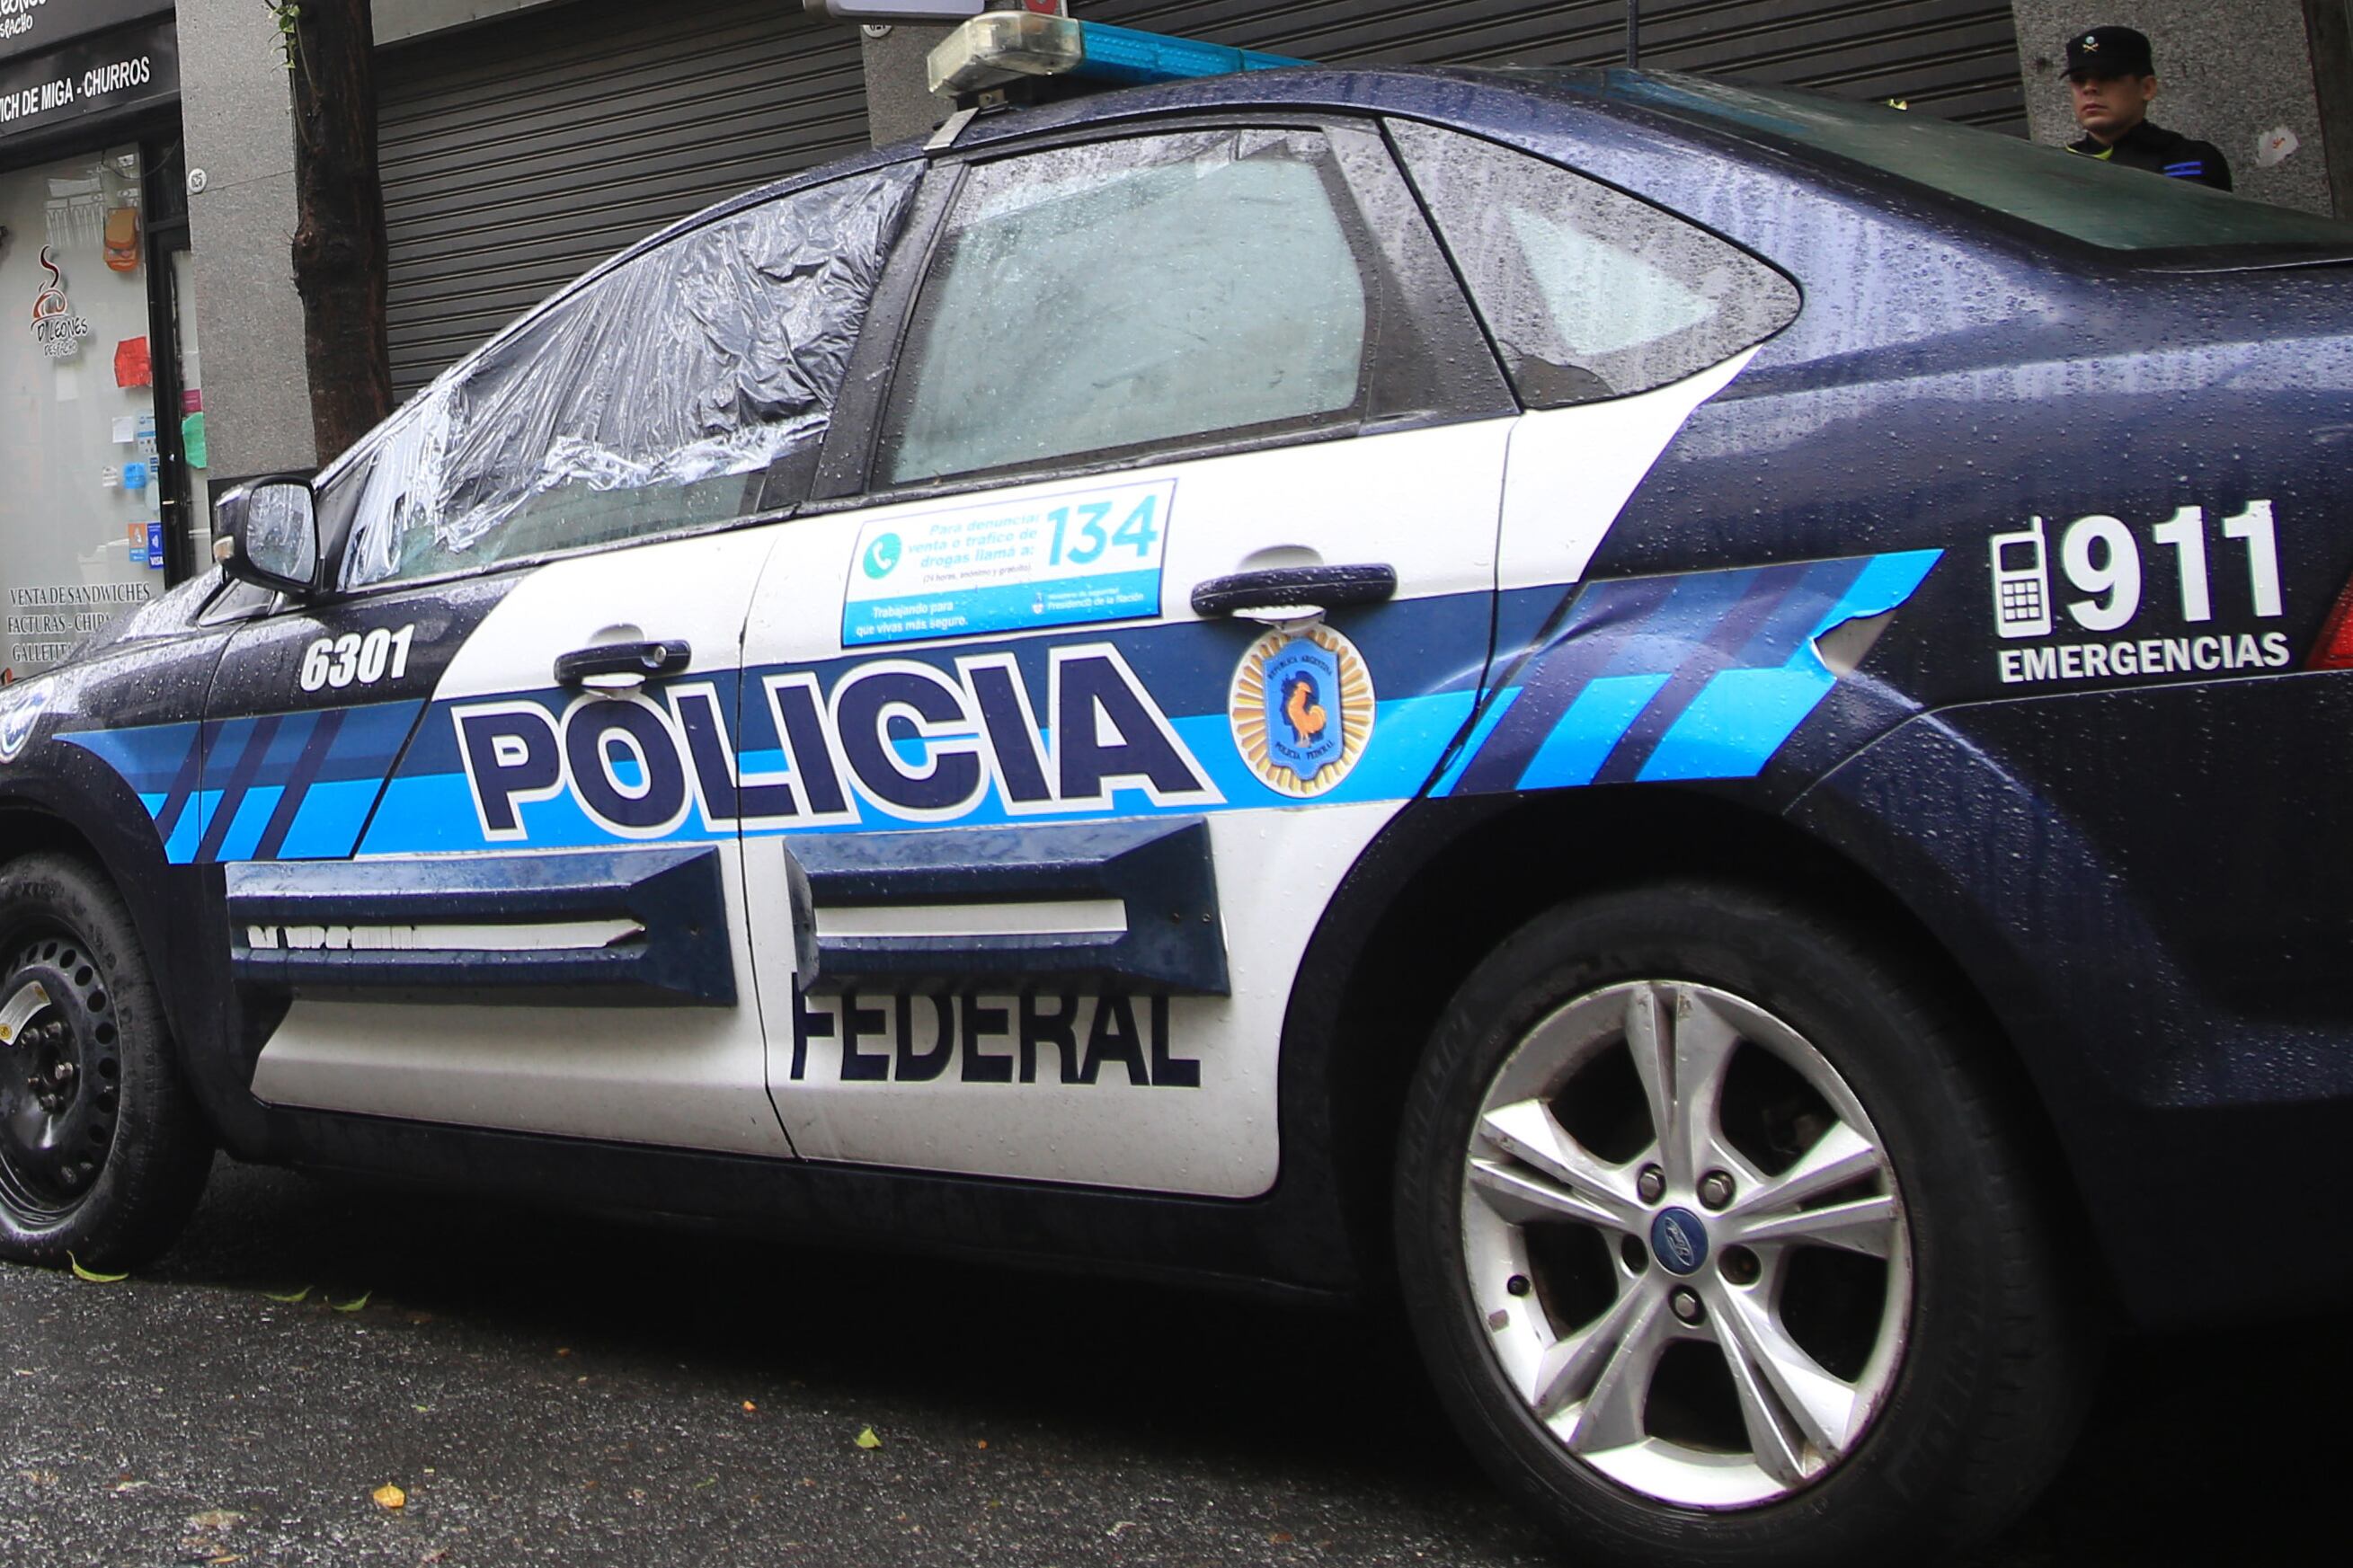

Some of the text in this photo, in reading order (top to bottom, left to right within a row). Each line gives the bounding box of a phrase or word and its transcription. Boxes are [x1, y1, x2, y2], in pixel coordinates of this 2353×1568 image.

[0, 96, 19, 123] ICH
[22, 87, 39, 117] DE
[41, 77, 74, 111] MIGA
[84, 56, 150, 98] CHURROS
[908, 540, 948, 554] venta
[952, 539, 961, 548] o
[1019, 528, 1038, 540] de
[929, 513, 1040, 536] Para denunciar
[1046, 494, 1159, 566] 134
[920, 554, 970, 569] drogas
[1020, 545, 1034, 556] a:
[2061, 499, 2283, 632] 911
[10, 582, 151, 606] VENTA DE SANDWICHES
[873, 601, 954, 618] Trabajando para
[7, 615, 66, 633] FACTURAS
[75, 612, 111, 632] CHIP
[856, 615, 969, 638] que vivas más seguro.
[300, 624, 415, 691] 6301
[1998, 632, 2290, 683] EMERGENCIAS
[450, 642, 1227, 841] POLICIA
[790, 971, 1202, 1087] FEDERAL
